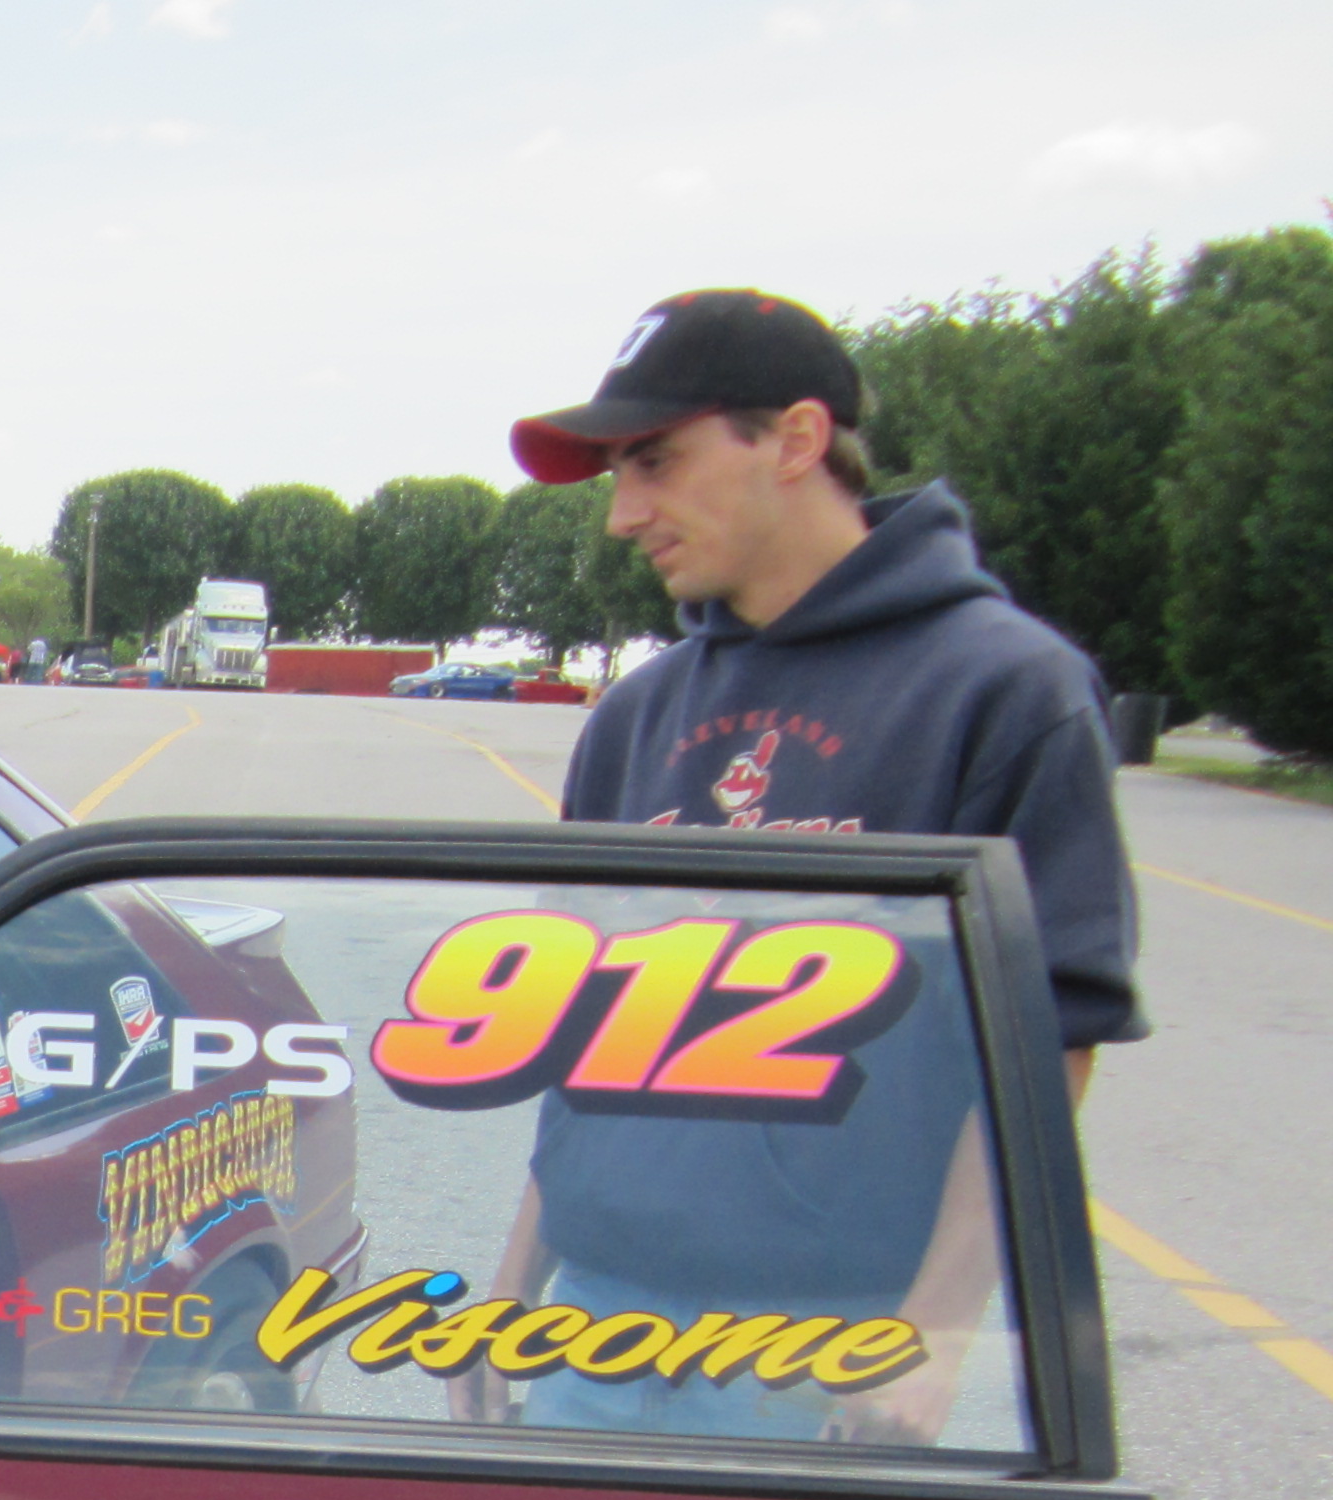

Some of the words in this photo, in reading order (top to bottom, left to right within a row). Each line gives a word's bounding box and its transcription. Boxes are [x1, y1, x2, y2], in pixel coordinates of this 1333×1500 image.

[6, 1012, 353, 1097] G/PS
[370, 908, 913, 1118] 912
[52, 1287, 214, 1340] GREG
[256, 1267, 925, 1388] Viscome
